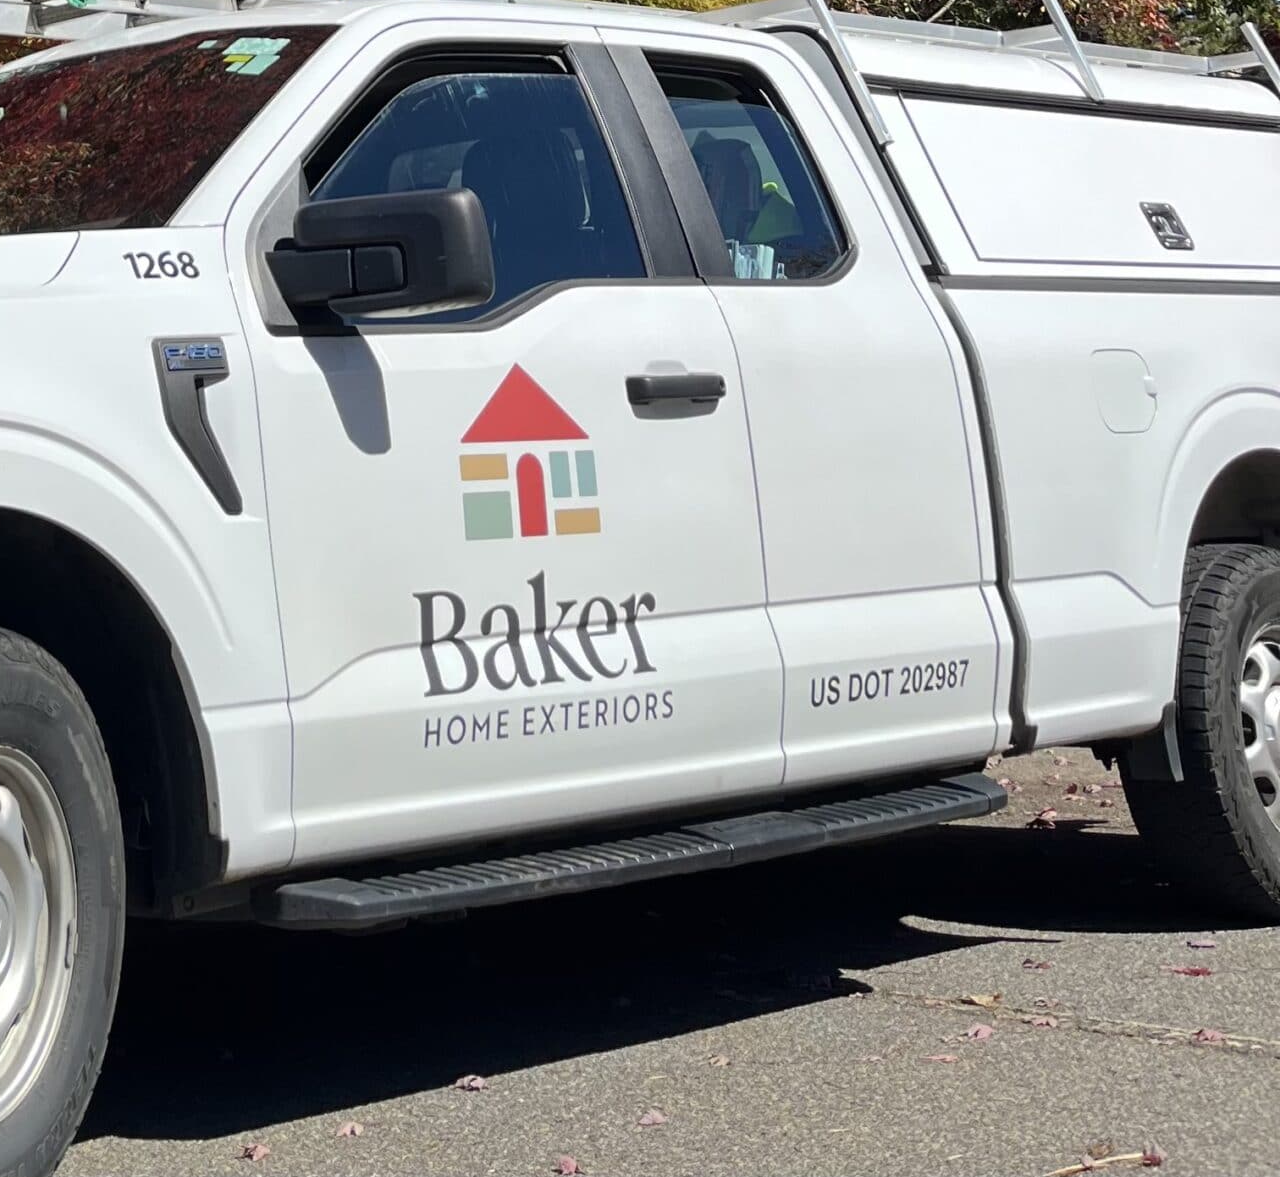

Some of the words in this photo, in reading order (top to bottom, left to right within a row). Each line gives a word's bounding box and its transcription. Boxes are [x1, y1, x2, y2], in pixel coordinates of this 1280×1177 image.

[122, 250, 201, 280] 1268
[412, 569, 658, 698] Baker
[810, 676, 841, 708] US
[848, 669, 895, 703] DOT
[899, 659, 970, 696] 202987
[424, 710, 510, 749] HOME
[522, 690, 674, 736] EXTERIORS
